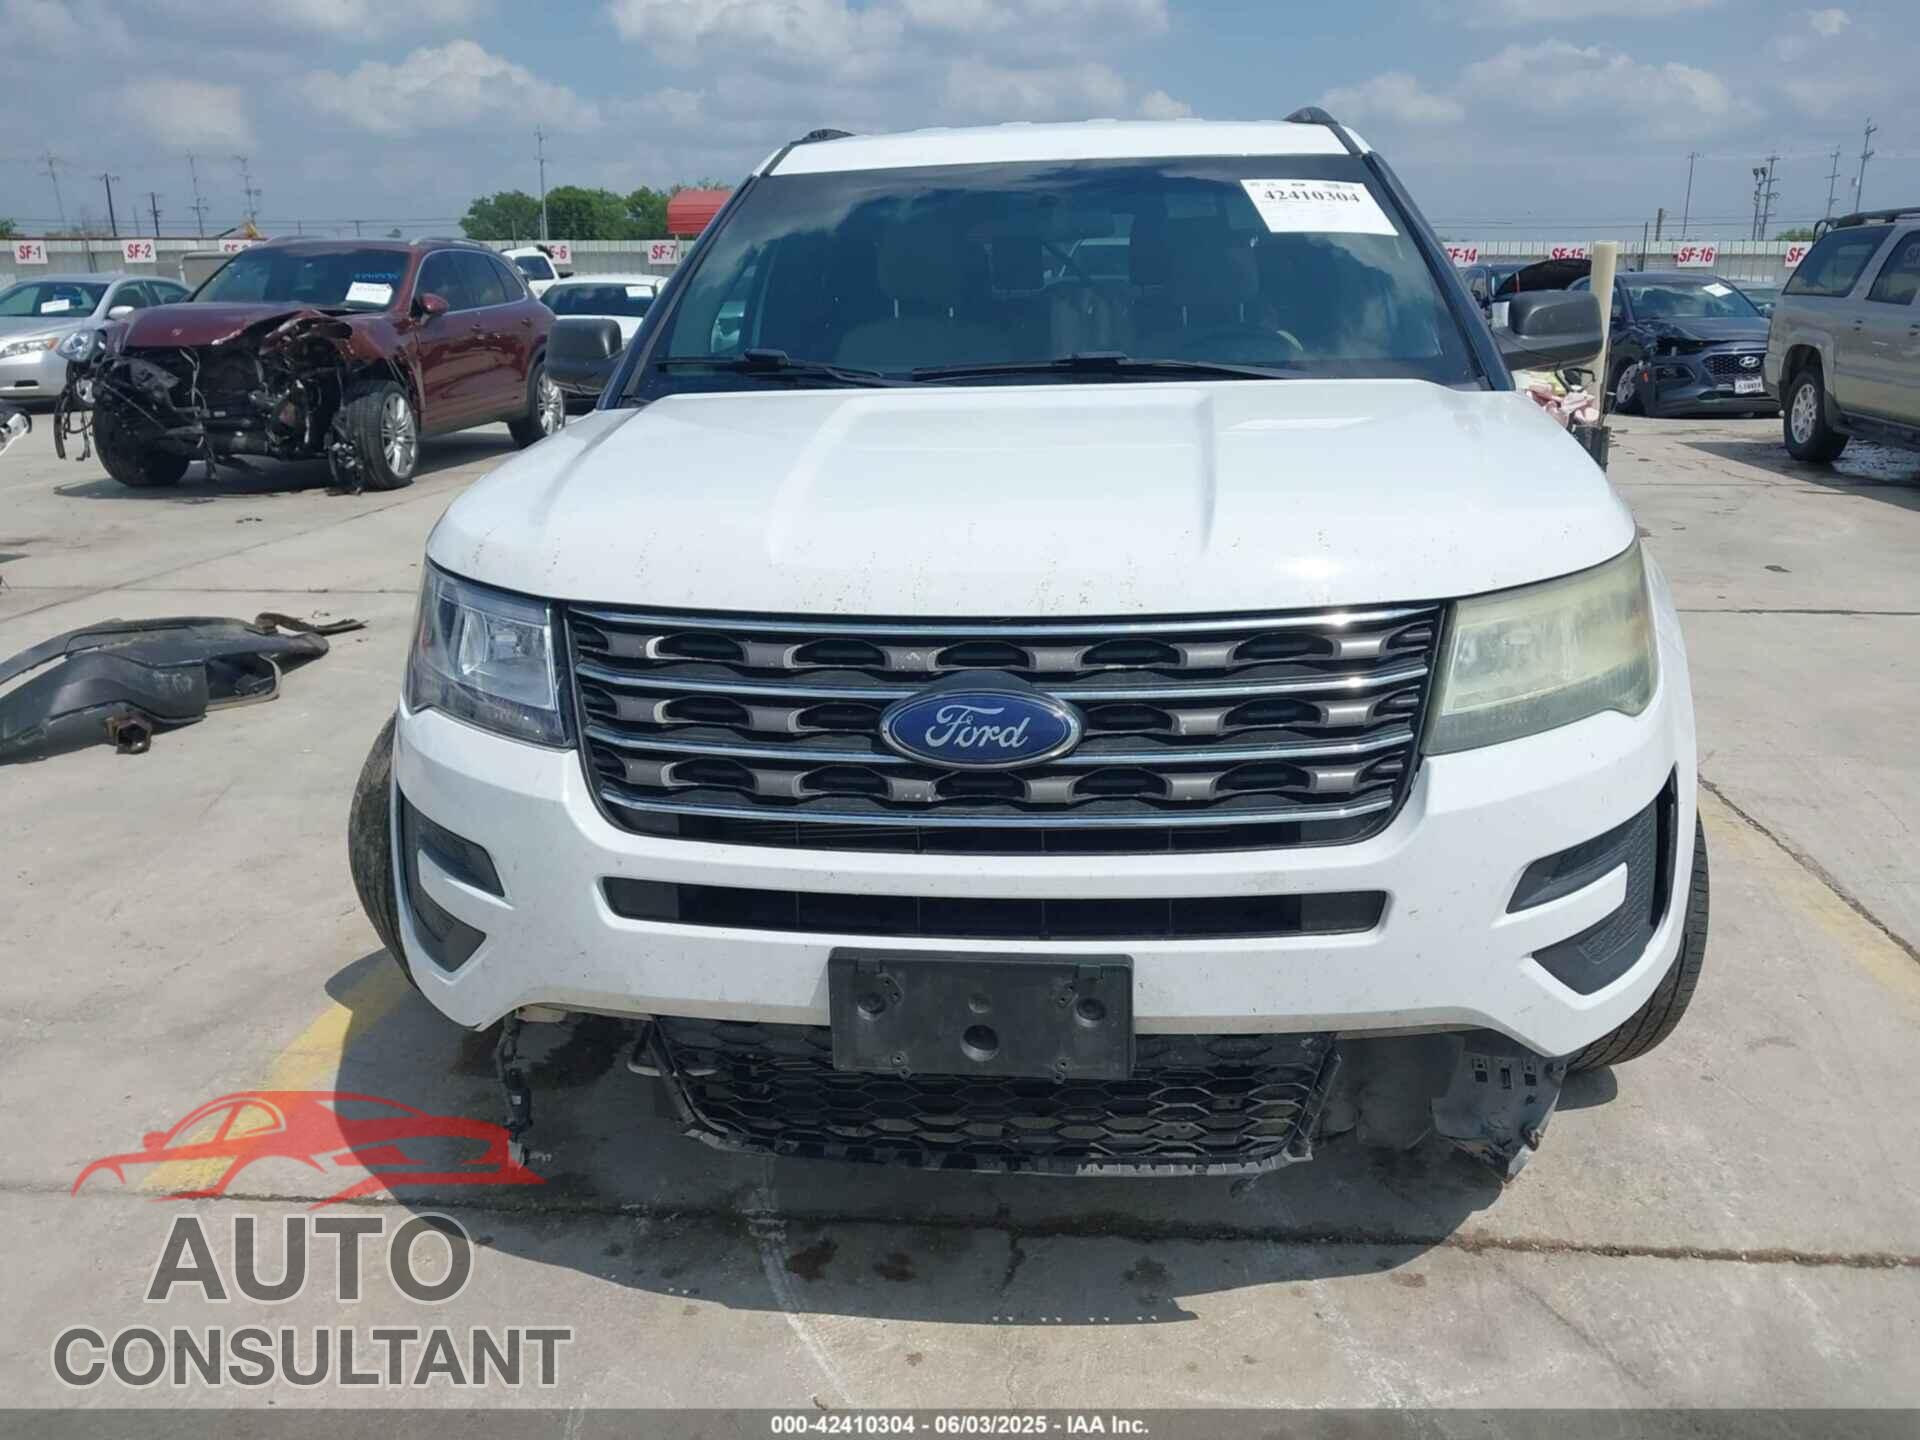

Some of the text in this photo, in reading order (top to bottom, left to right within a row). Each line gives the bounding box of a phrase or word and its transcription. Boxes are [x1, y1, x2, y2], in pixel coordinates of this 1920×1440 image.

[1264, 190, 1360, 203] 42410304
[19, 245, 42, 260] SF-1
[127, 244, 152, 258] SF-2
[651, 246, 677, 259] SF-7
[1679, 247, 1713, 262] SF-16
[925, 704, 1031, 748] Ford
